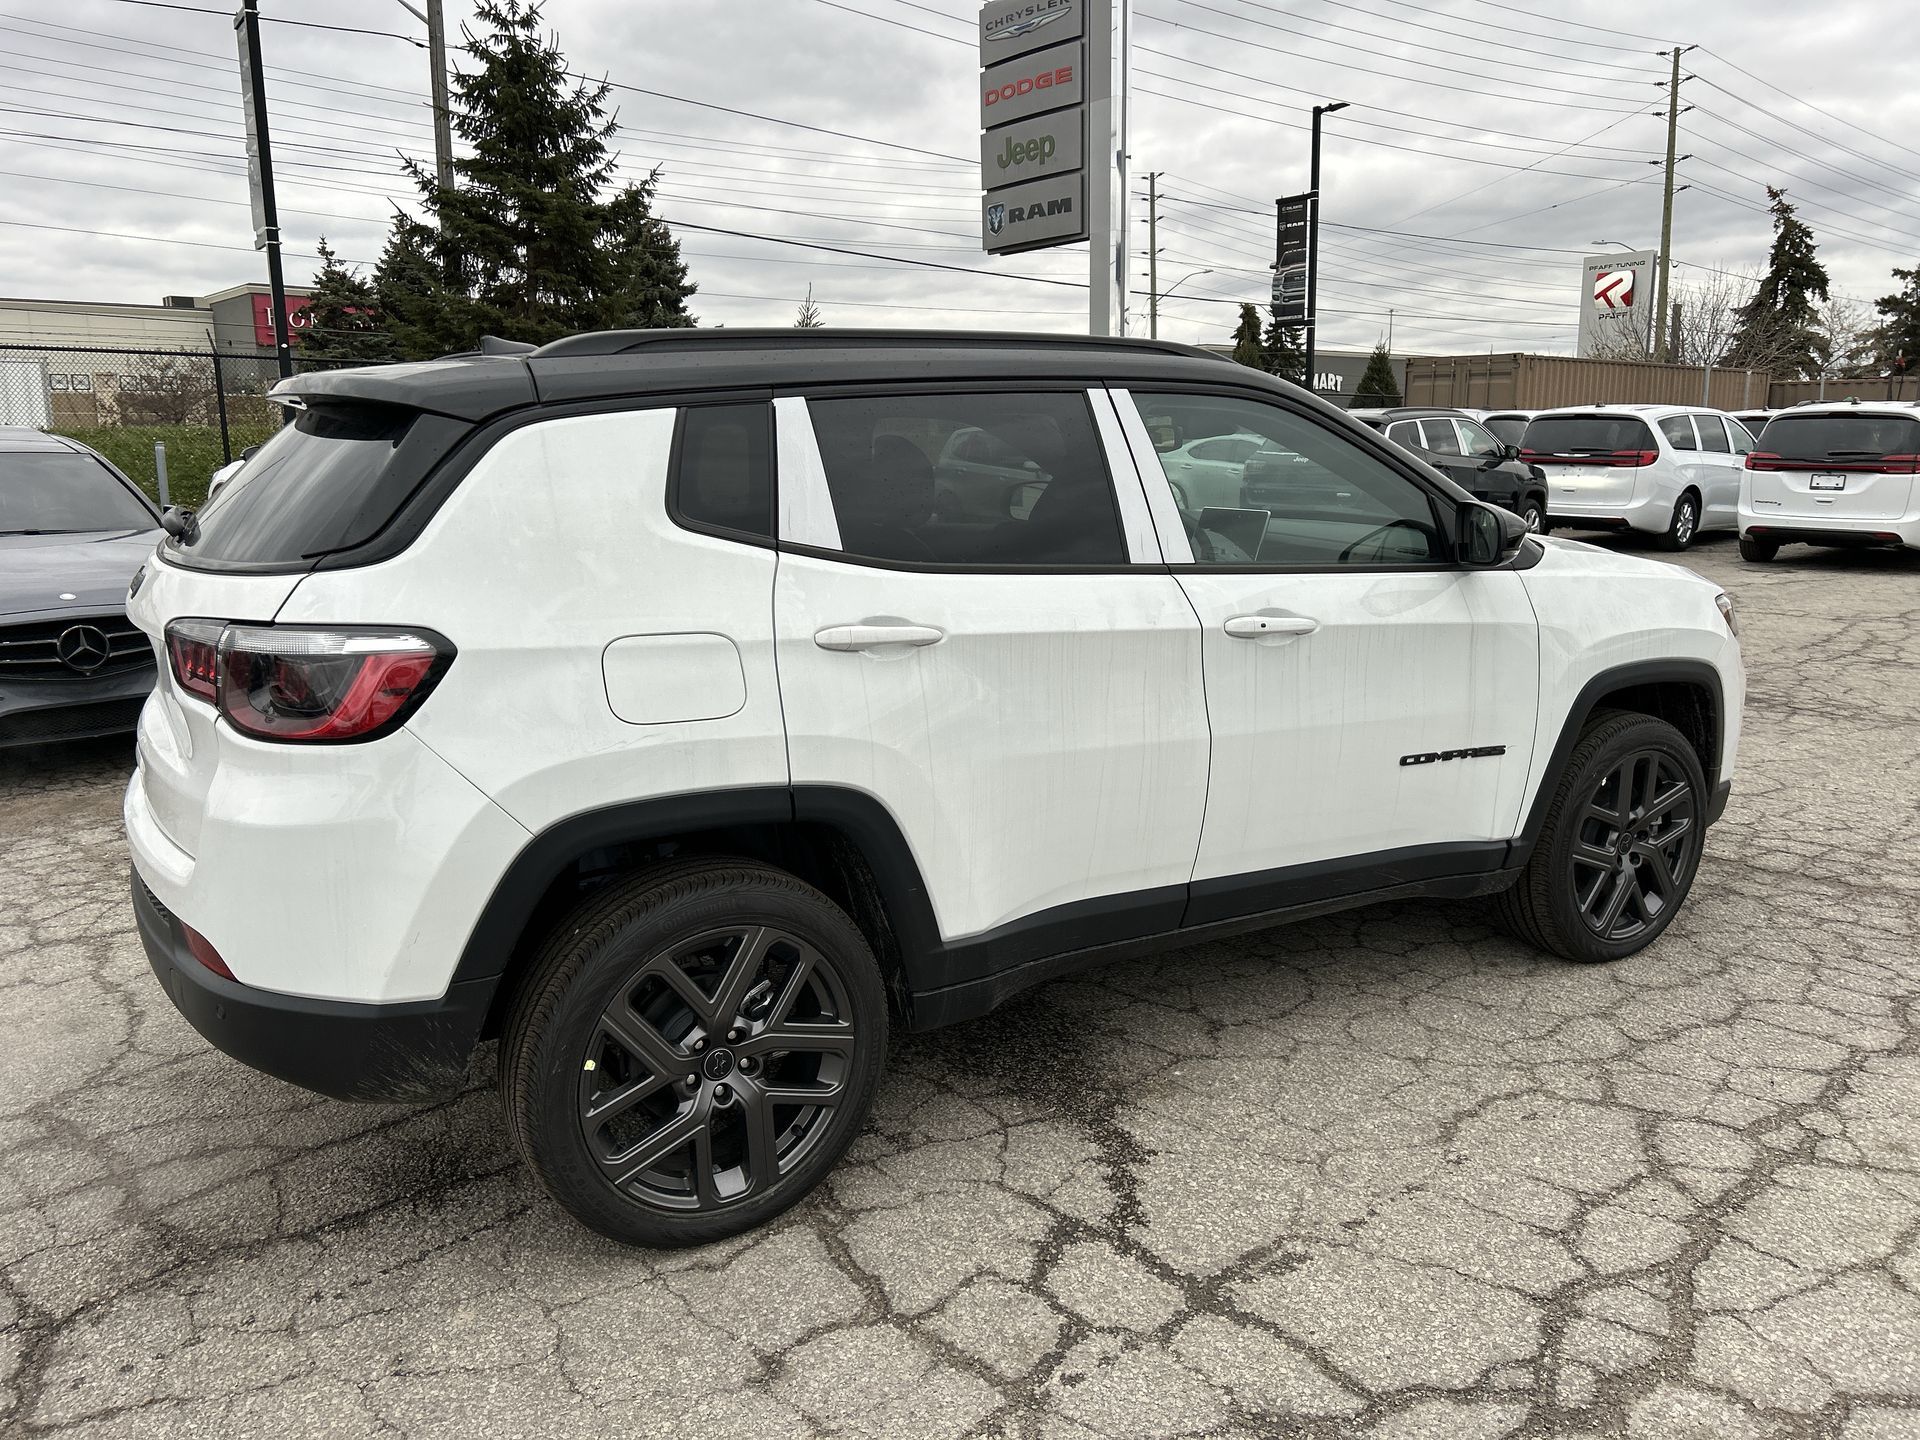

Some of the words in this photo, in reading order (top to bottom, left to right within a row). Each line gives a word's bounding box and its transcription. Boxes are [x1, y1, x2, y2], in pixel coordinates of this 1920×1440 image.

[985, 66, 1073, 106] DODGE
[997, 134, 1055, 169] Jeep
[1008, 197, 1072, 223] RAM
[1599, 312, 1628, 320] PFAFF
[1293, 455, 1309, 463] Jeep
[1399, 745, 1506, 766] COMPASS
